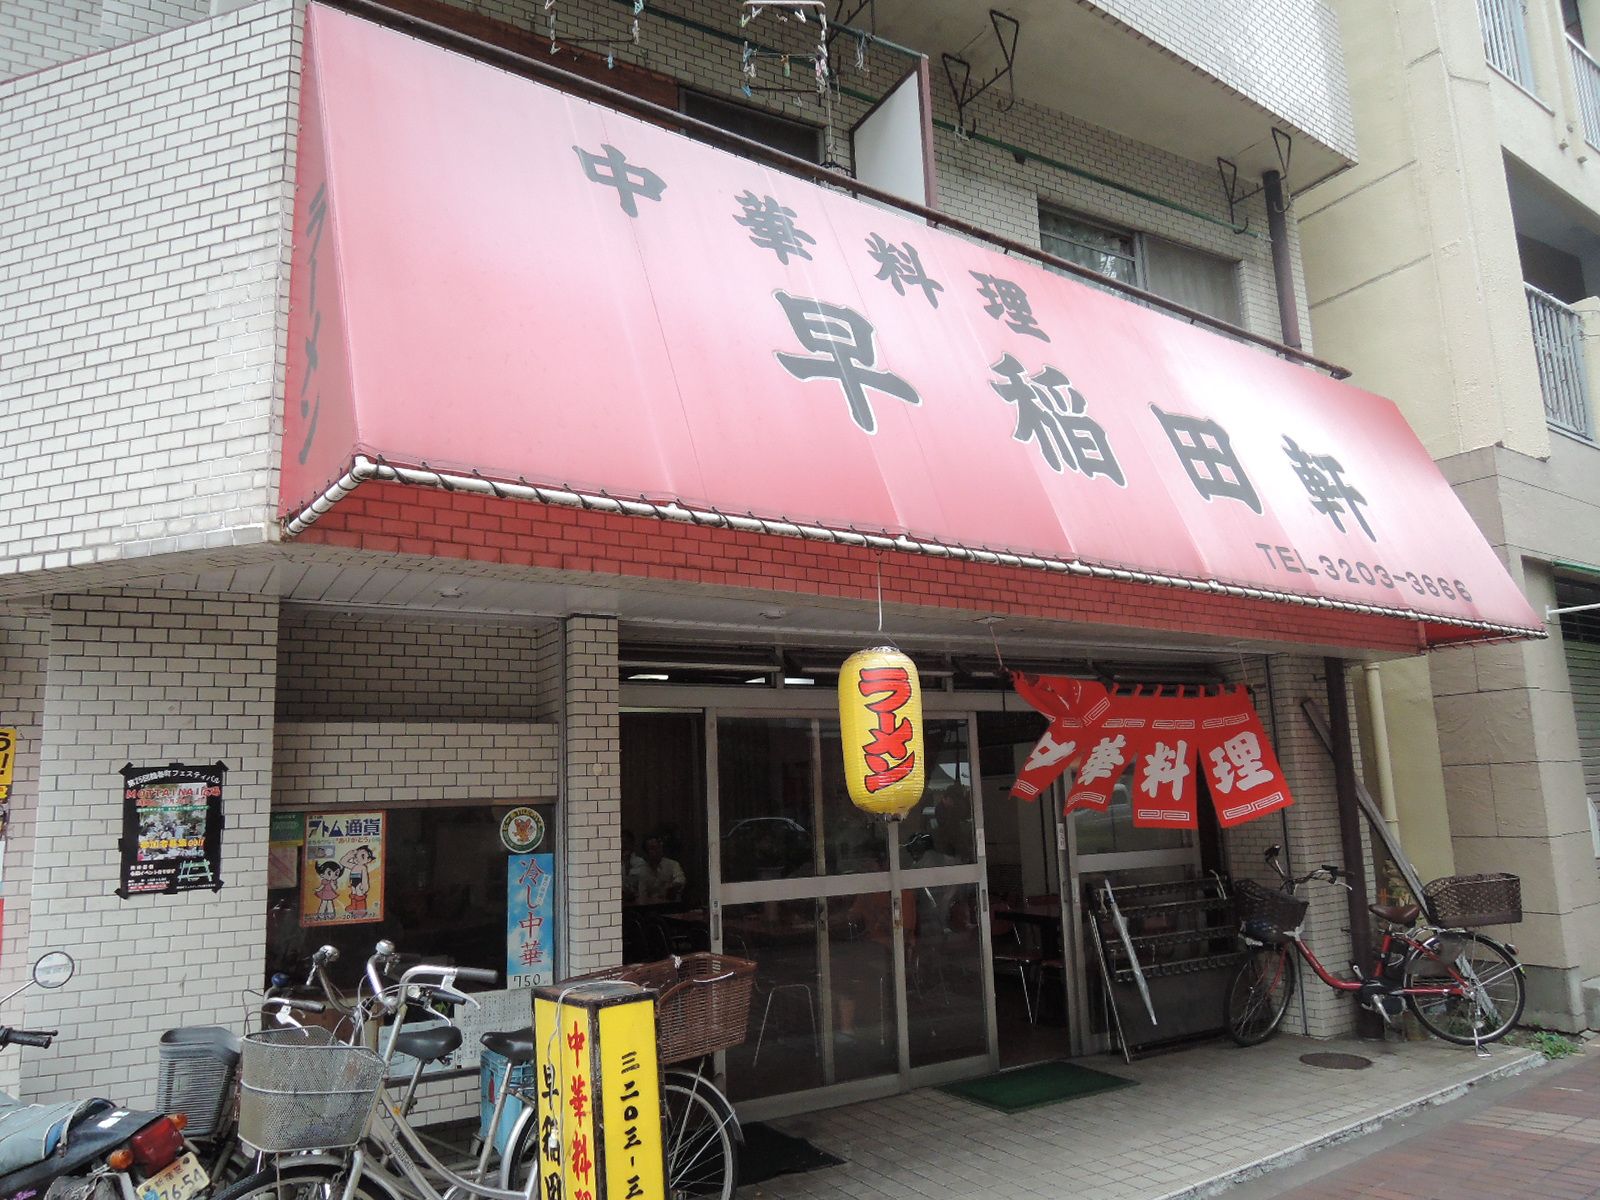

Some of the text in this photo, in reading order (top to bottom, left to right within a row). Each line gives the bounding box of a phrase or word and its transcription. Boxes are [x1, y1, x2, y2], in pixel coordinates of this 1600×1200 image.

[572, 143, 1052, 344] 中華料理
[298, 181, 328, 465] ラーメン
[772, 288, 1378, 543] 早稲田軒
[1255, 542, 1473, 603] TEL 3203-3666
[857, 666, 916, 794] ラーメン
[308, 818, 381, 838] アトム通貨
[518, 858, 545, 967] 冷し中華
[513, 973, 541, 988] 750
[567, 1020, 593, 1200] 中華料
